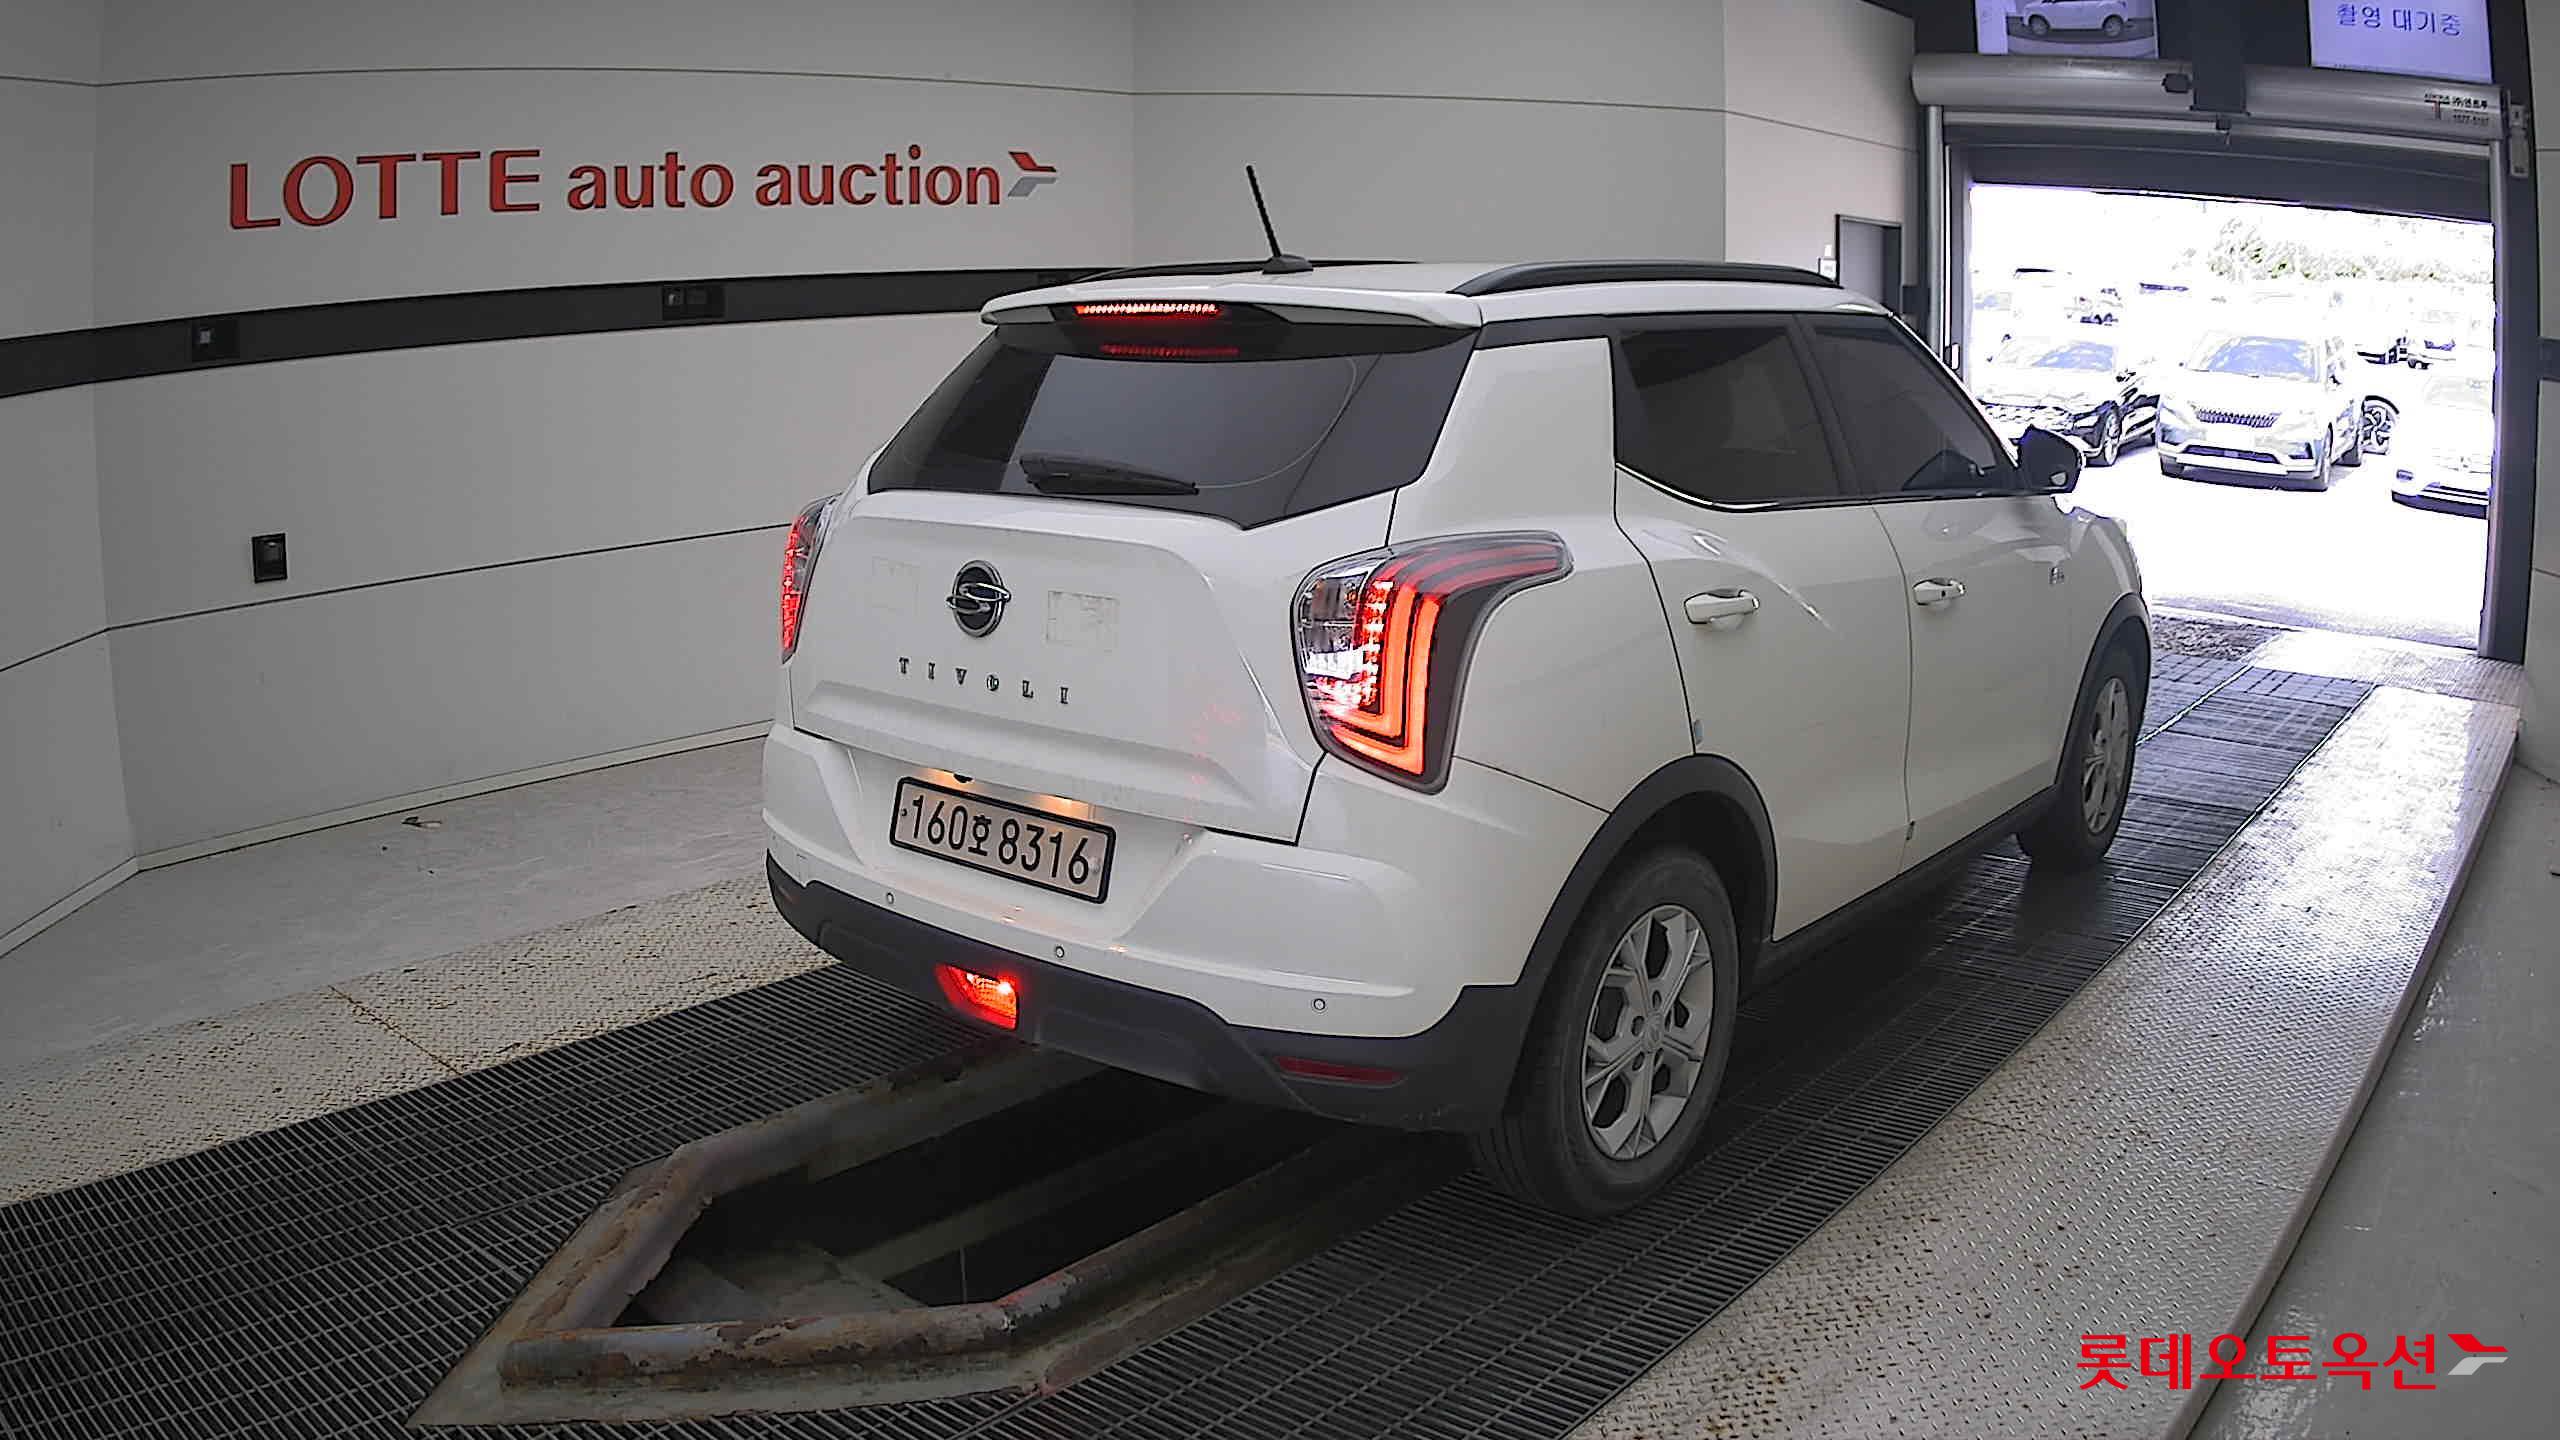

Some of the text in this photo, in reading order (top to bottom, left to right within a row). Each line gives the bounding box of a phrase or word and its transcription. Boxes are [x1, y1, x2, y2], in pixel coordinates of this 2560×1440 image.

[2337, 4, 2461, 36] 촬영 대기중
[230, 145, 1000, 229] LOTTE auto auction
[899, 657, 1070, 704] TIVOLI
